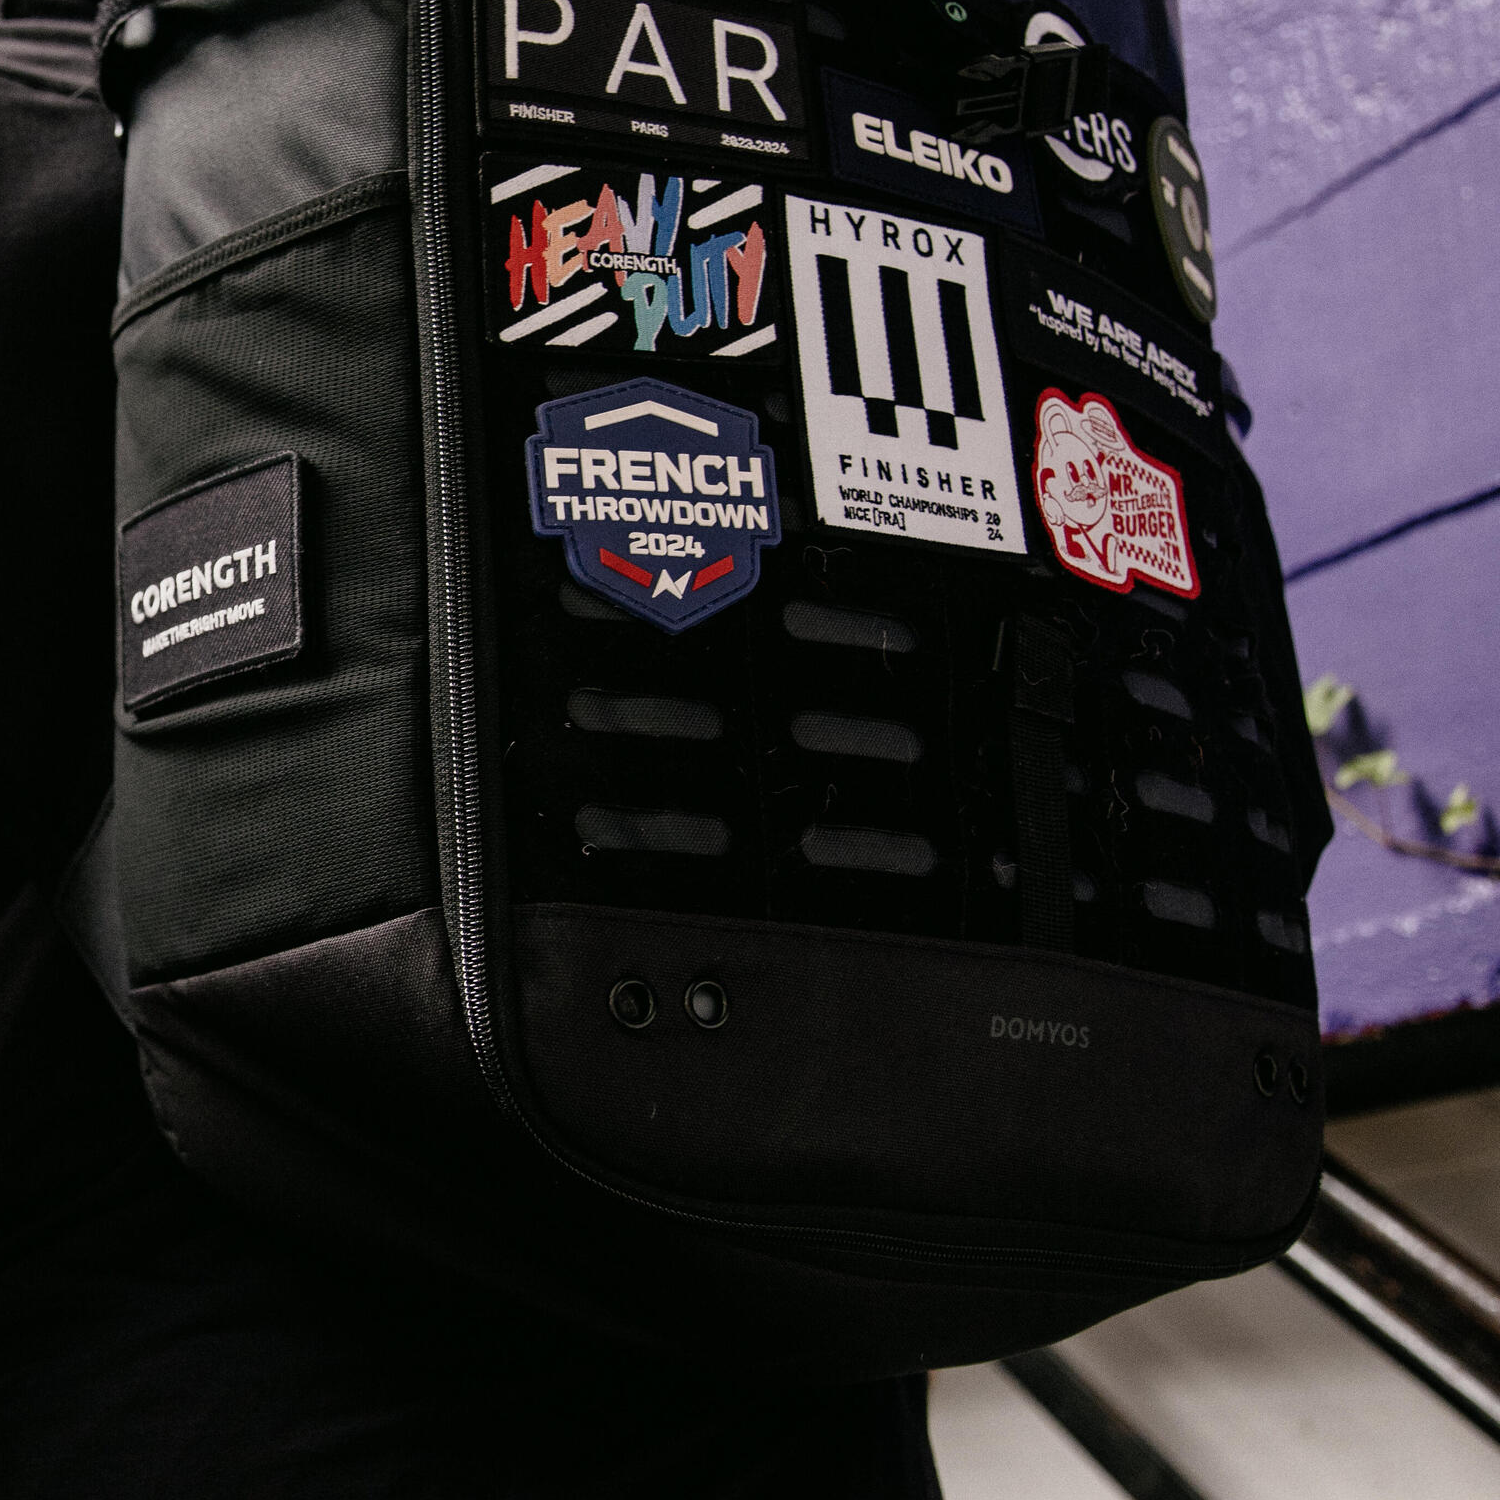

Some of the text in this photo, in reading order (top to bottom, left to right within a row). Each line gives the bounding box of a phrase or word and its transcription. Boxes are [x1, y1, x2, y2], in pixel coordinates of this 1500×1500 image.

[509, 103, 576, 125] FINISHER
[630, 120, 669, 138] PARIS
[852, 112, 1014, 194] ELEIKO
[505, 173, 684, 312] HEAVY
[810, 204, 965, 266] HYROX
[589, 252, 679, 275] CORENGTH
[619, 220, 767, 352] DUTY
[1046, 289, 1198, 394] WE ARE APEX
[543, 447, 765, 498] FRENCH
[838, 454, 997, 501] FINISHER
[1108, 471, 1139, 498] MR.
[547, 495, 769, 531] THROWDOWN
[838, 485, 883, 505] WORLD
[888, 493, 979, 523] CHAMPIONSHIPS
[844, 505, 906, 531] NICE [FRA]
[628, 531, 706, 559] 2024
[986, 527, 1003, 542] 24
[1111, 510, 1178, 542] BURGER
[131, 539, 278, 625] CORENGTH
[190, 609, 228, 636] RIGHT
[227, 598, 266, 625] MOVE
[990, 1014, 1091, 1049] DOMYOS
